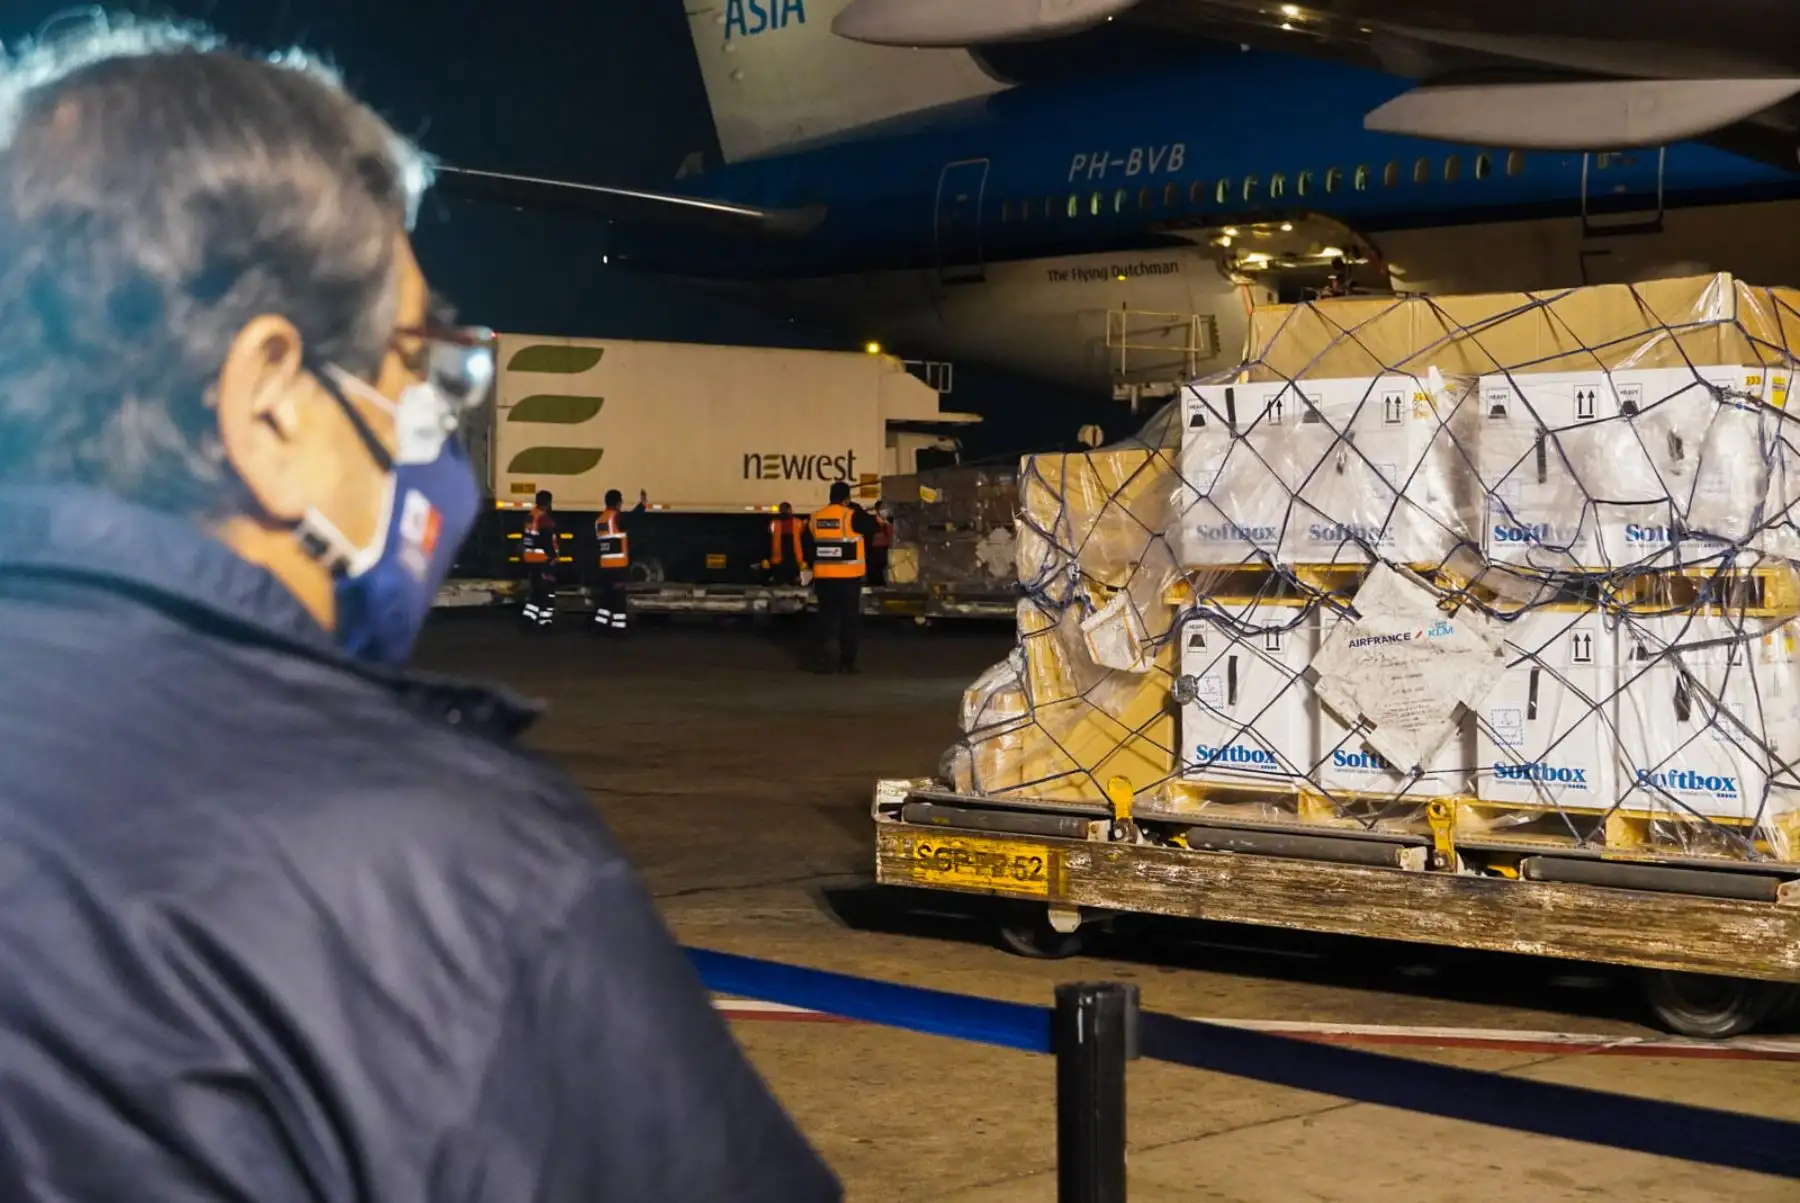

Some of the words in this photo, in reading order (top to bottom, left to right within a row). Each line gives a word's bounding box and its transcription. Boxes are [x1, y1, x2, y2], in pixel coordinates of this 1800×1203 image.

[1068, 143, 1185, 183] PH-BVB
[1047, 268, 1070, 283] The
[1110, 260, 1179, 278] Dutchman
[1428, 625, 1454, 637] KLM
[1196, 744, 1278, 764] Softbox
[1494, 762, 1586, 783] Softbox
